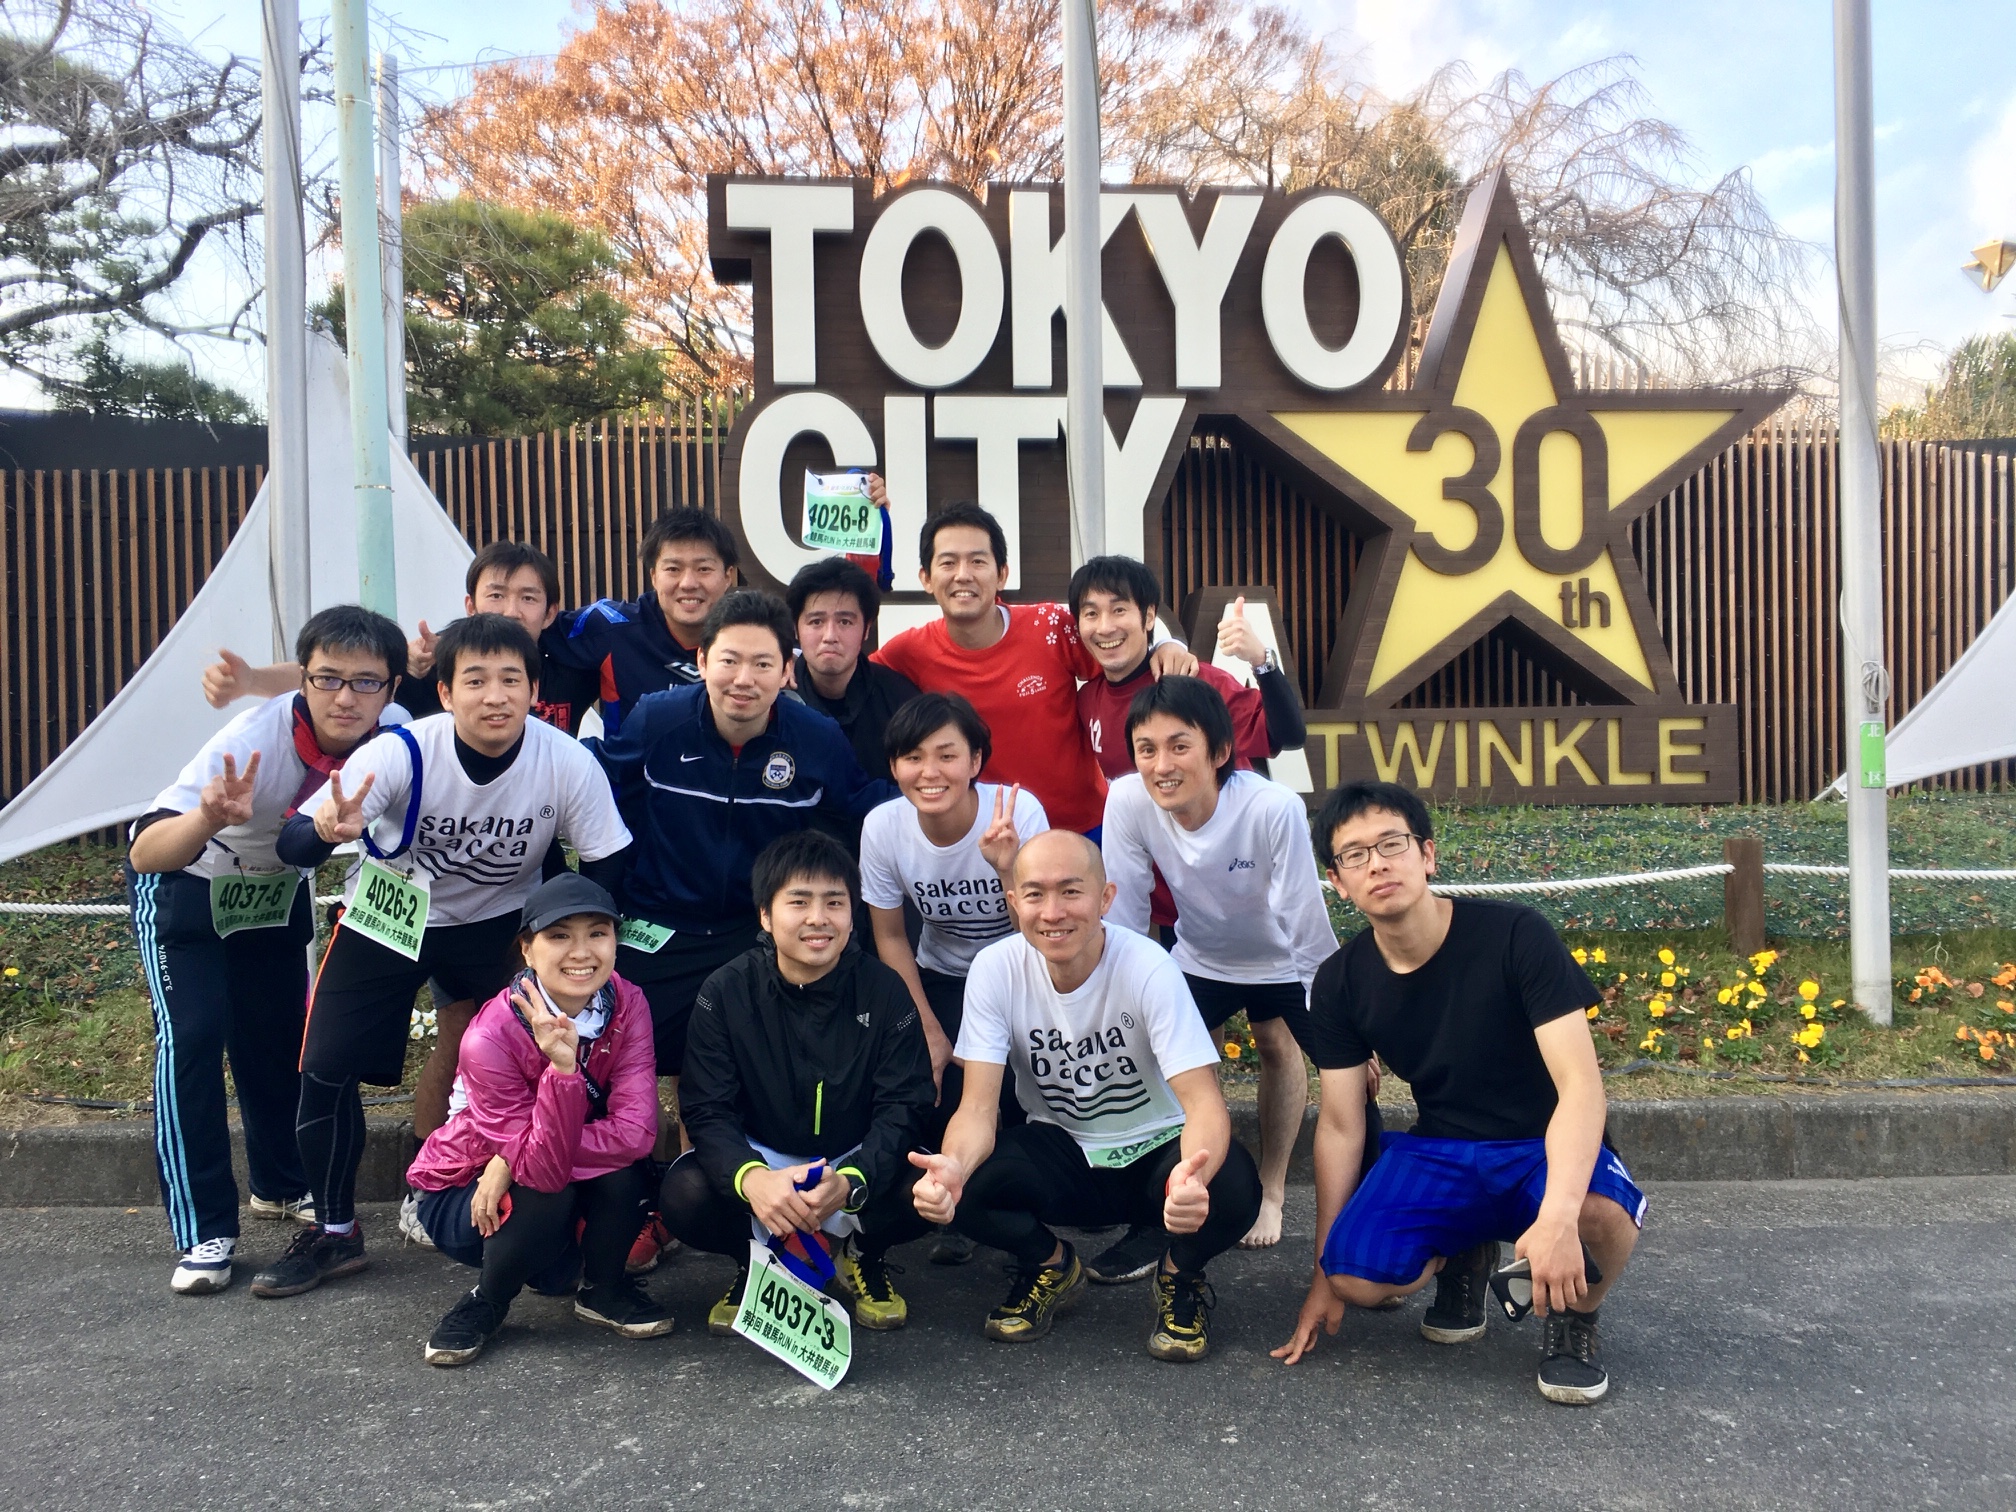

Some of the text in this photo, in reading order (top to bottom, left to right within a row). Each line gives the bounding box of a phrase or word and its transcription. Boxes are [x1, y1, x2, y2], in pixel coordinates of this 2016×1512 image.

[727, 183, 1402, 388] TOKYO
[740, 392, 1186, 590] CITY
[1406, 405, 1609, 576] 30
[809, 503, 869, 533] 4026-8
[1559, 578, 1612, 628] th
[1306, 717, 1709, 789] TWINKLE
[418, 830, 528, 858] bacca
[420, 815, 534, 838] sakana
[218, 881, 286, 912] 4037-6
[366, 874, 418, 929] 4026-2
[914, 878, 1004, 898] sakana
[918, 897, 1008, 916] bacca
[1031, 1053, 1138, 1087] bacca
[585, 1078, 600, 1099] SON
[760, 1280, 835, 1351] 4037-3
[797, 1345, 840, 1381] 大井競馬場
